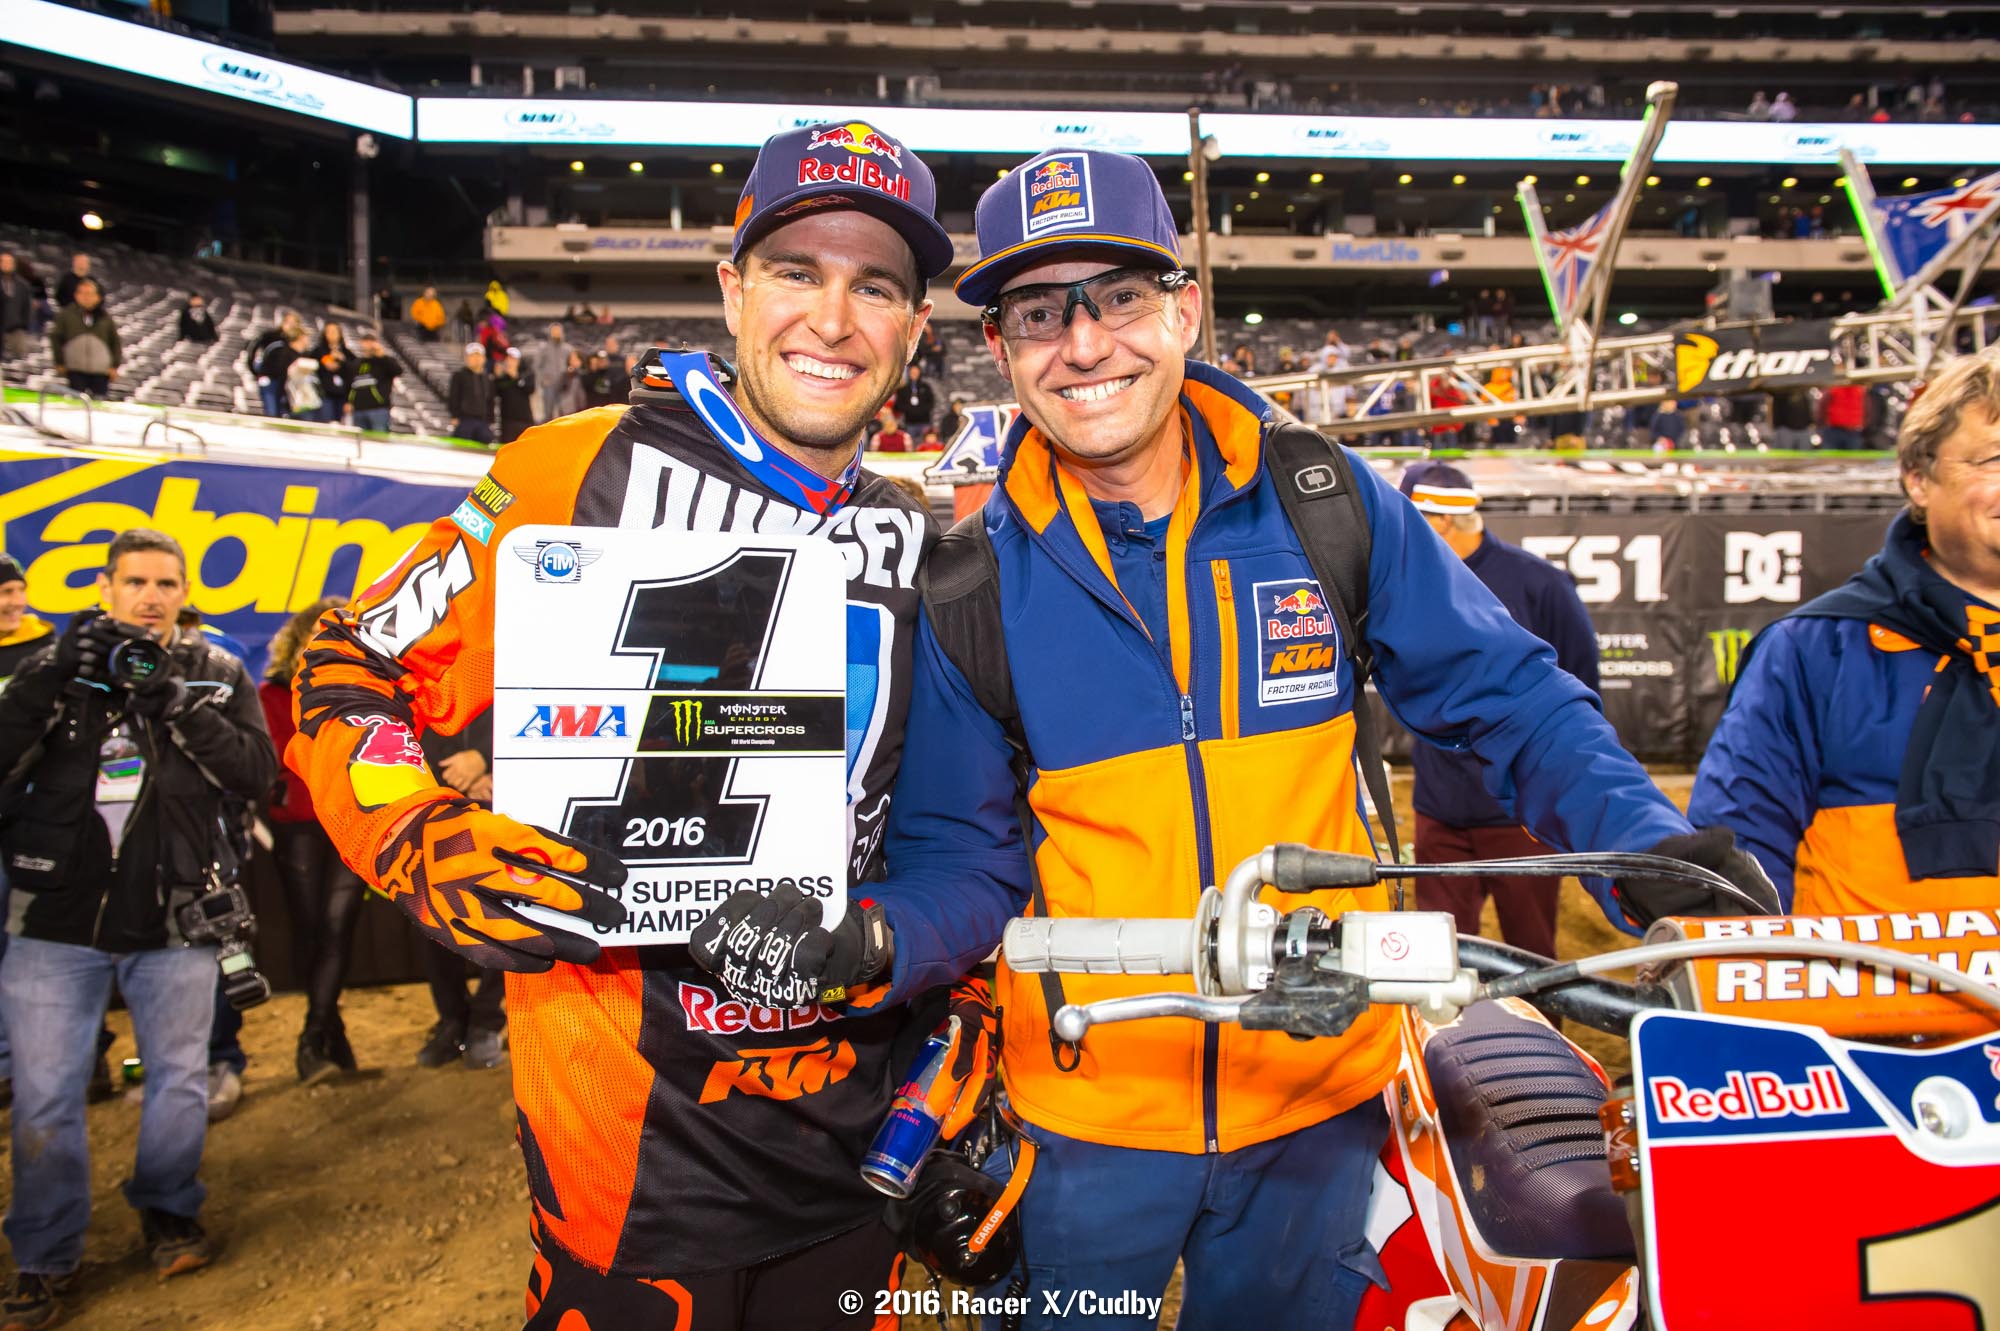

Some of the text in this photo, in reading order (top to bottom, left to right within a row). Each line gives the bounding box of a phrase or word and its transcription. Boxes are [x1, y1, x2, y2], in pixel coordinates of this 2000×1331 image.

[798, 155, 911, 203] Red Bull
[1031, 173, 1079, 197] Red Bull
[1032, 190, 1081, 216] KTM
[1032, 210, 1083, 227] FACTORY RACING
[592, 237, 642, 250] BUD
[1331, 240, 1420, 261] MetLife
[1708, 349, 1831, 381] thor
[543, 554, 575, 571] FIM
[1725, 531, 1802, 603] DC
[358, 536, 476, 660] KTM
[1268, 613, 1333, 640] Red Bull
[1269, 642, 1334, 674] KTM
[1266, 679, 1333, 695] FACTORY RACING
[510, 703, 632, 738] AMA
[556, 546, 797, 868] 1
[720, 704, 787, 716] MONSTER
[704, 726, 806, 735] SUPERCROSS
[622, 816, 707, 848] 2016
[1702, 909, 2000, 942] RENTHA
[699, 1037, 857, 1104] KTM
[1648, 1064, 1851, 1124] Red Bull
[896, 1113, 921, 1127] DRINK
[973, 1209, 1004, 1246] CARLOS
